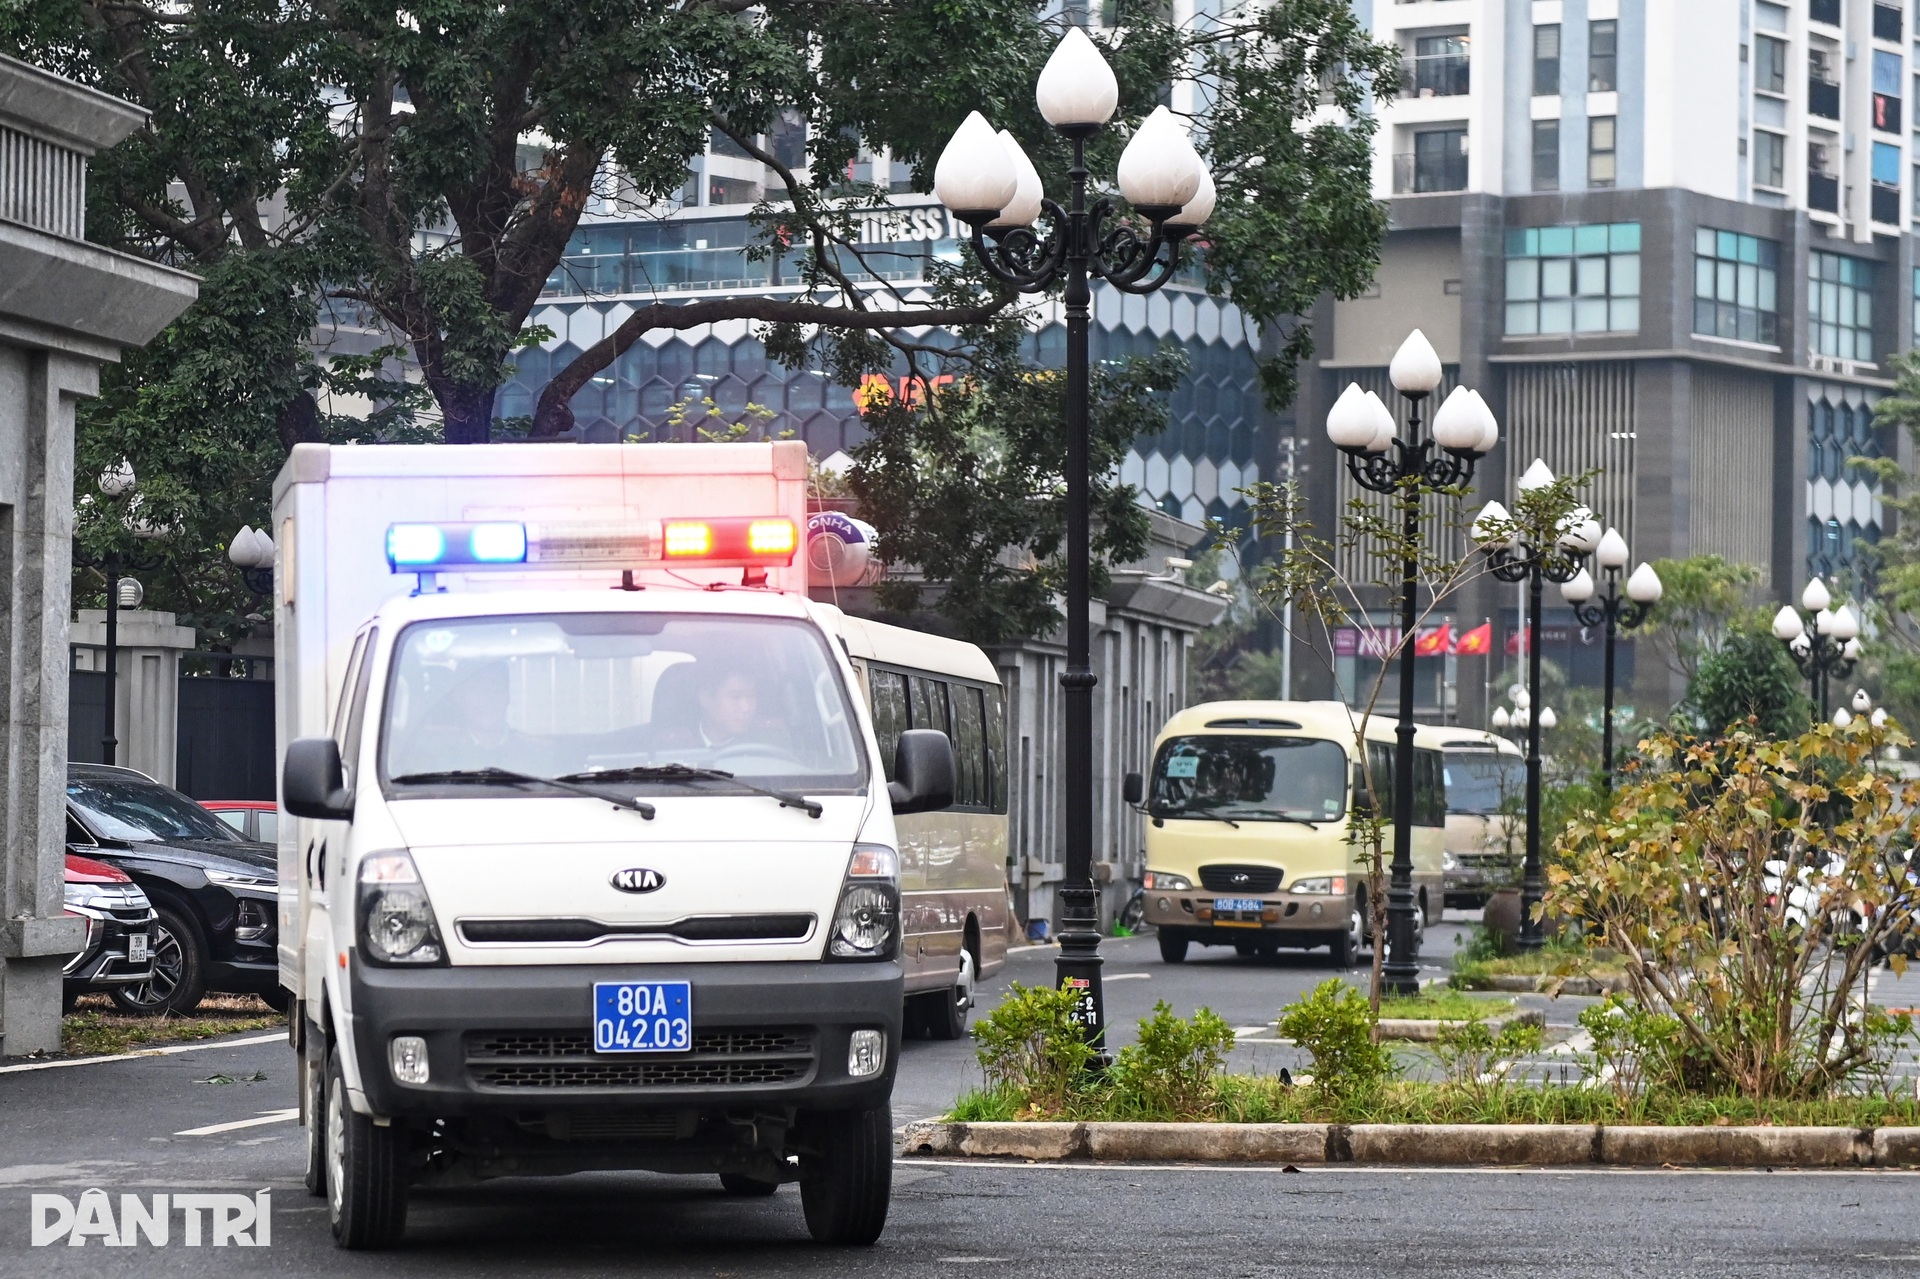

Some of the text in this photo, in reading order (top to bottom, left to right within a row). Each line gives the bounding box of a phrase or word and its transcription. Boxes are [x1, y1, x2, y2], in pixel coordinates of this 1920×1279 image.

[806, 517, 852, 535] ONHA
[618, 870, 658, 888] KIA
[617, 985, 668, 1016] 80A
[597, 1017, 688, 1049] 042.03
